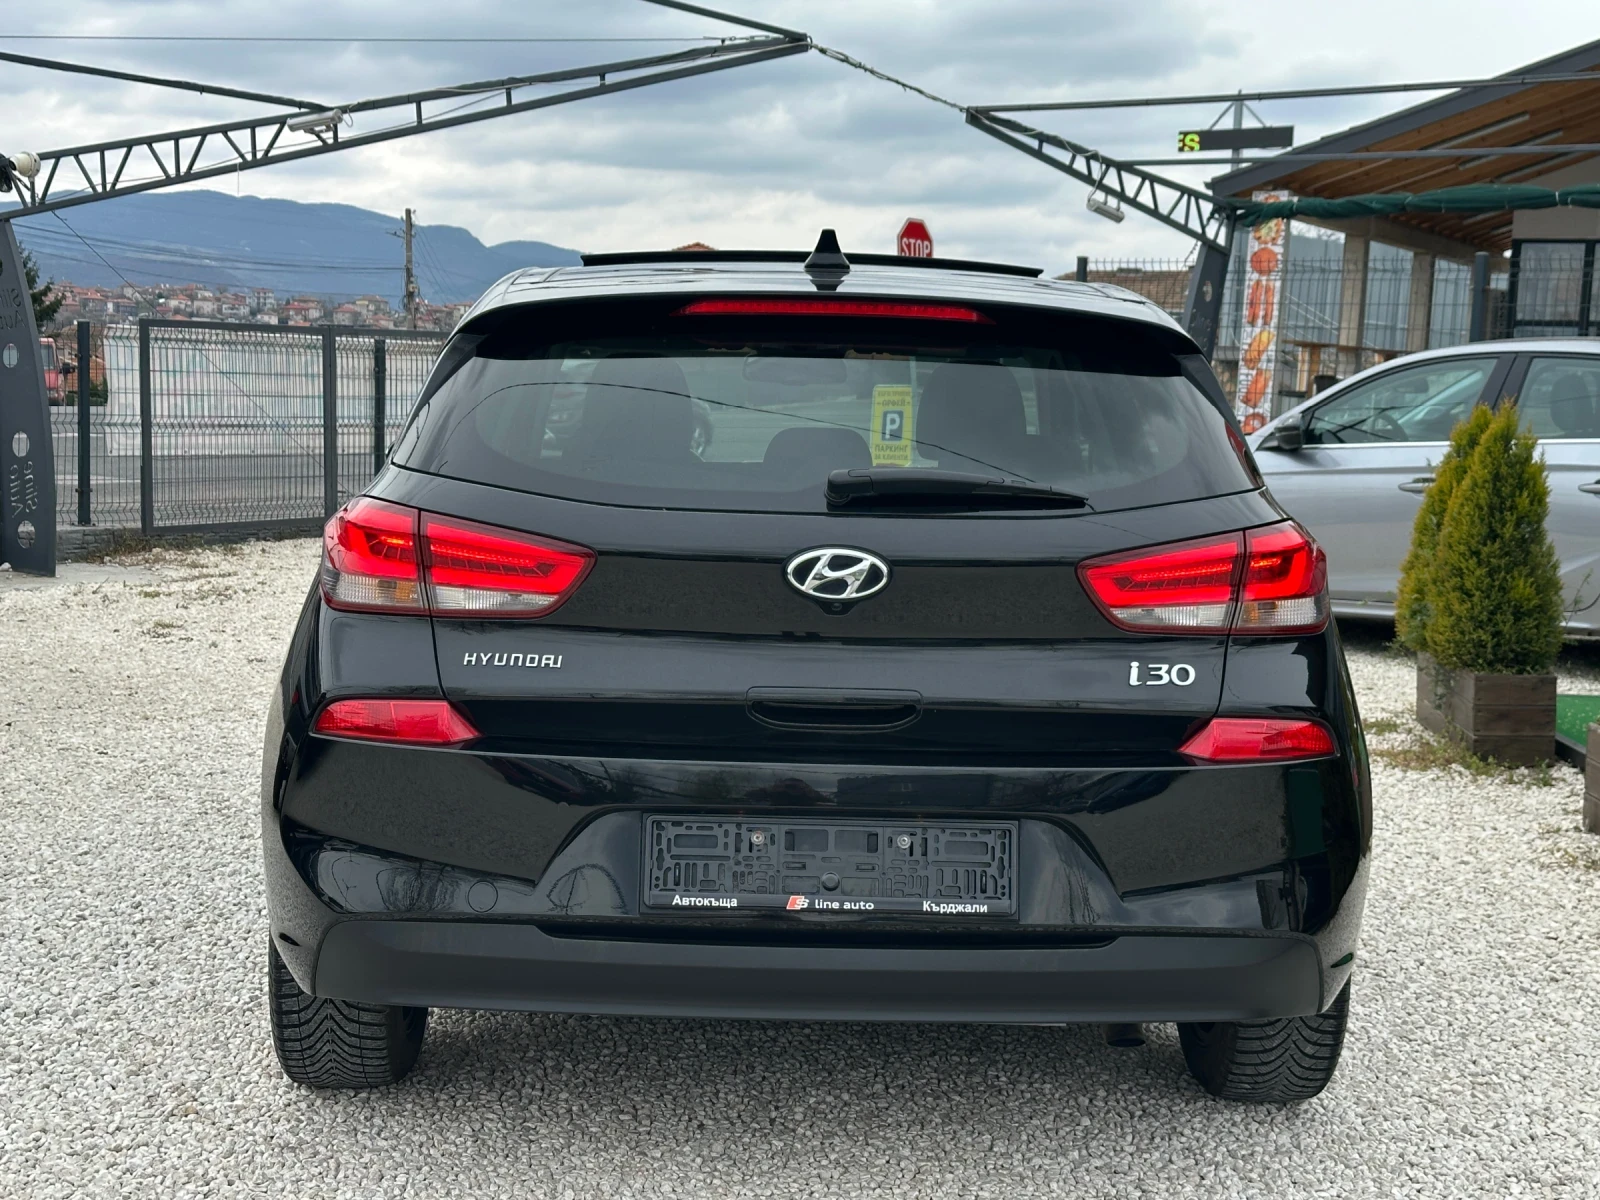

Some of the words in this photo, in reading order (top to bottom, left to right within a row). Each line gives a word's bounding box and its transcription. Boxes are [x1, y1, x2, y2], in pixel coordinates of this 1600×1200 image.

[901, 237, 931, 258] STOP
[875, 444, 908, 453] ПАРКИНГ
[463, 652, 563, 669] HYUNDAI
[672, 895, 738, 908] Автокъща
[815, 899, 840, 909] line
[843, 901, 875, 910] auto
[922, 900, 988, 914] Кърджали
